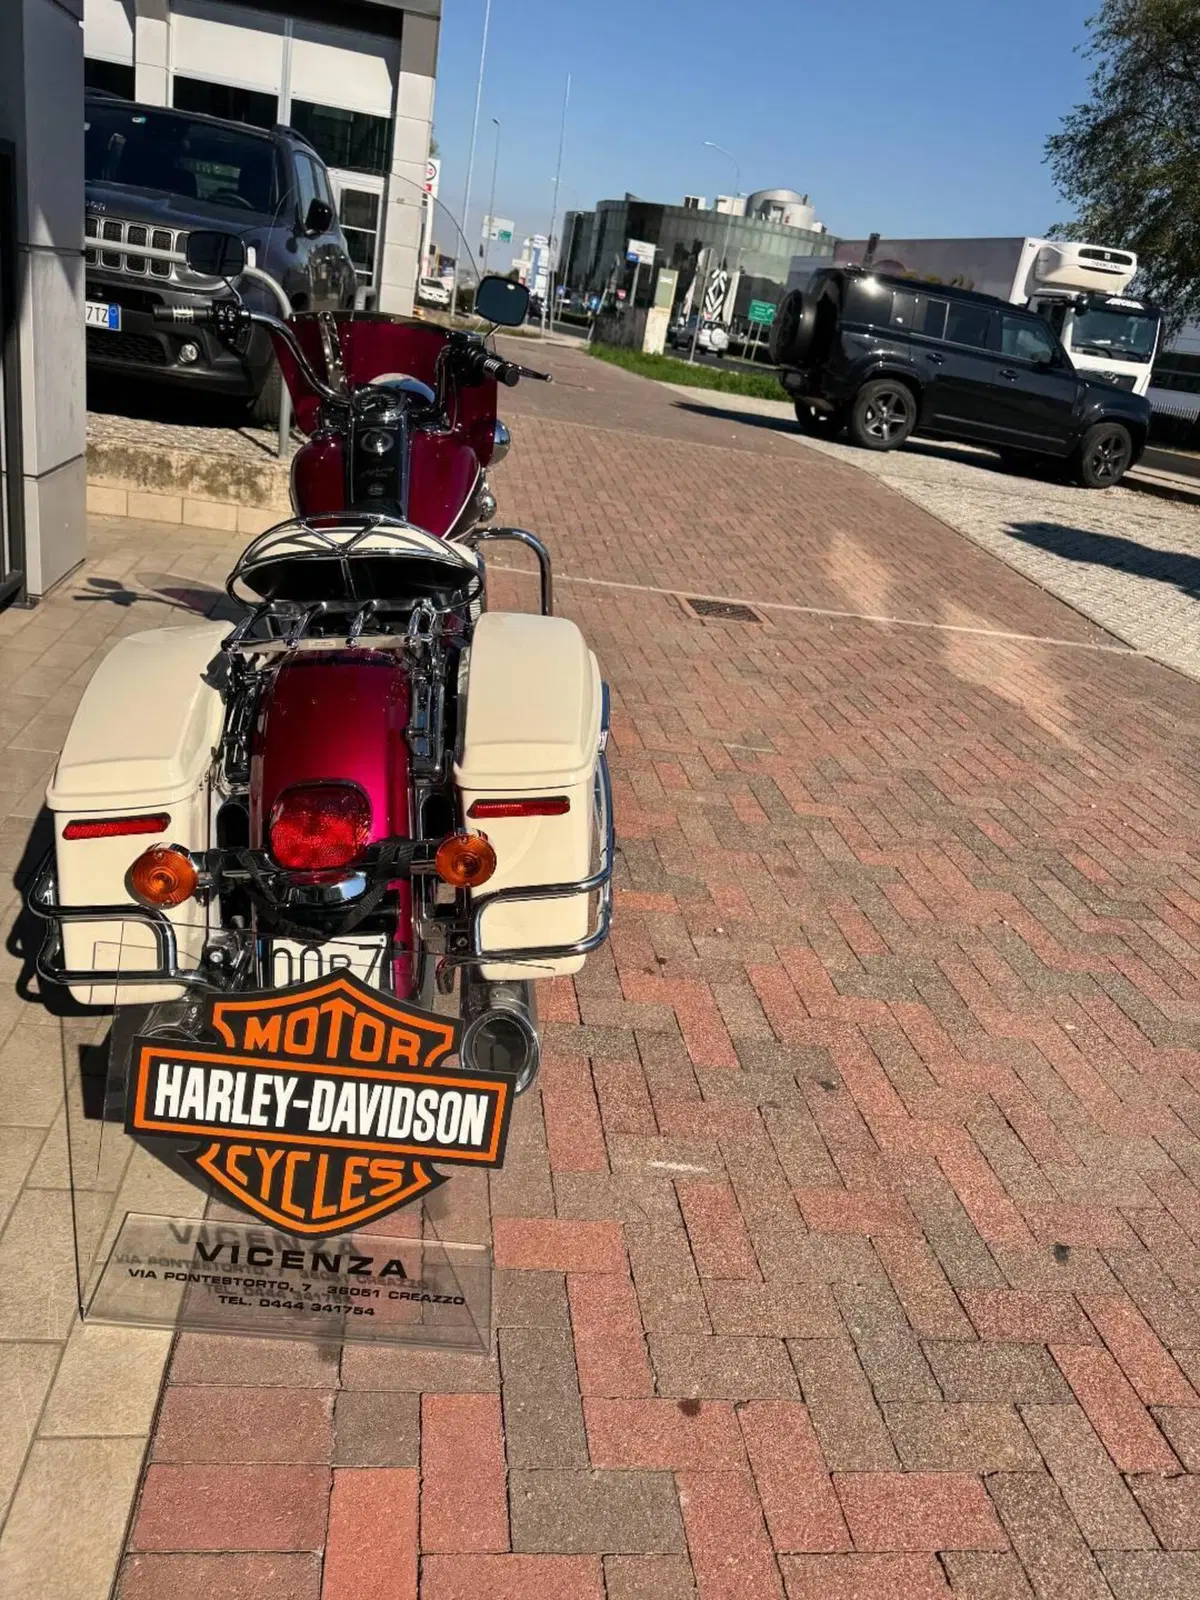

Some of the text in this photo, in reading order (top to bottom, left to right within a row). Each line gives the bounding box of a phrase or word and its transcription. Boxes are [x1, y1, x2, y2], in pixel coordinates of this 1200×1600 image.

[243, 997, 422, 1067] MOTOR
[153, 1063, 489, 1146] HARLEY-DAVIDSON
[226, 1146, 406, 1220] CYCLES
[128, 1268, 466, 1306] VIA PONTESTORTO, 7 36051 CREAZZO
[196, 1241, 408, 1279] VICENZA
[218, 1295, 376, 1317] TEL. 0444 341754
